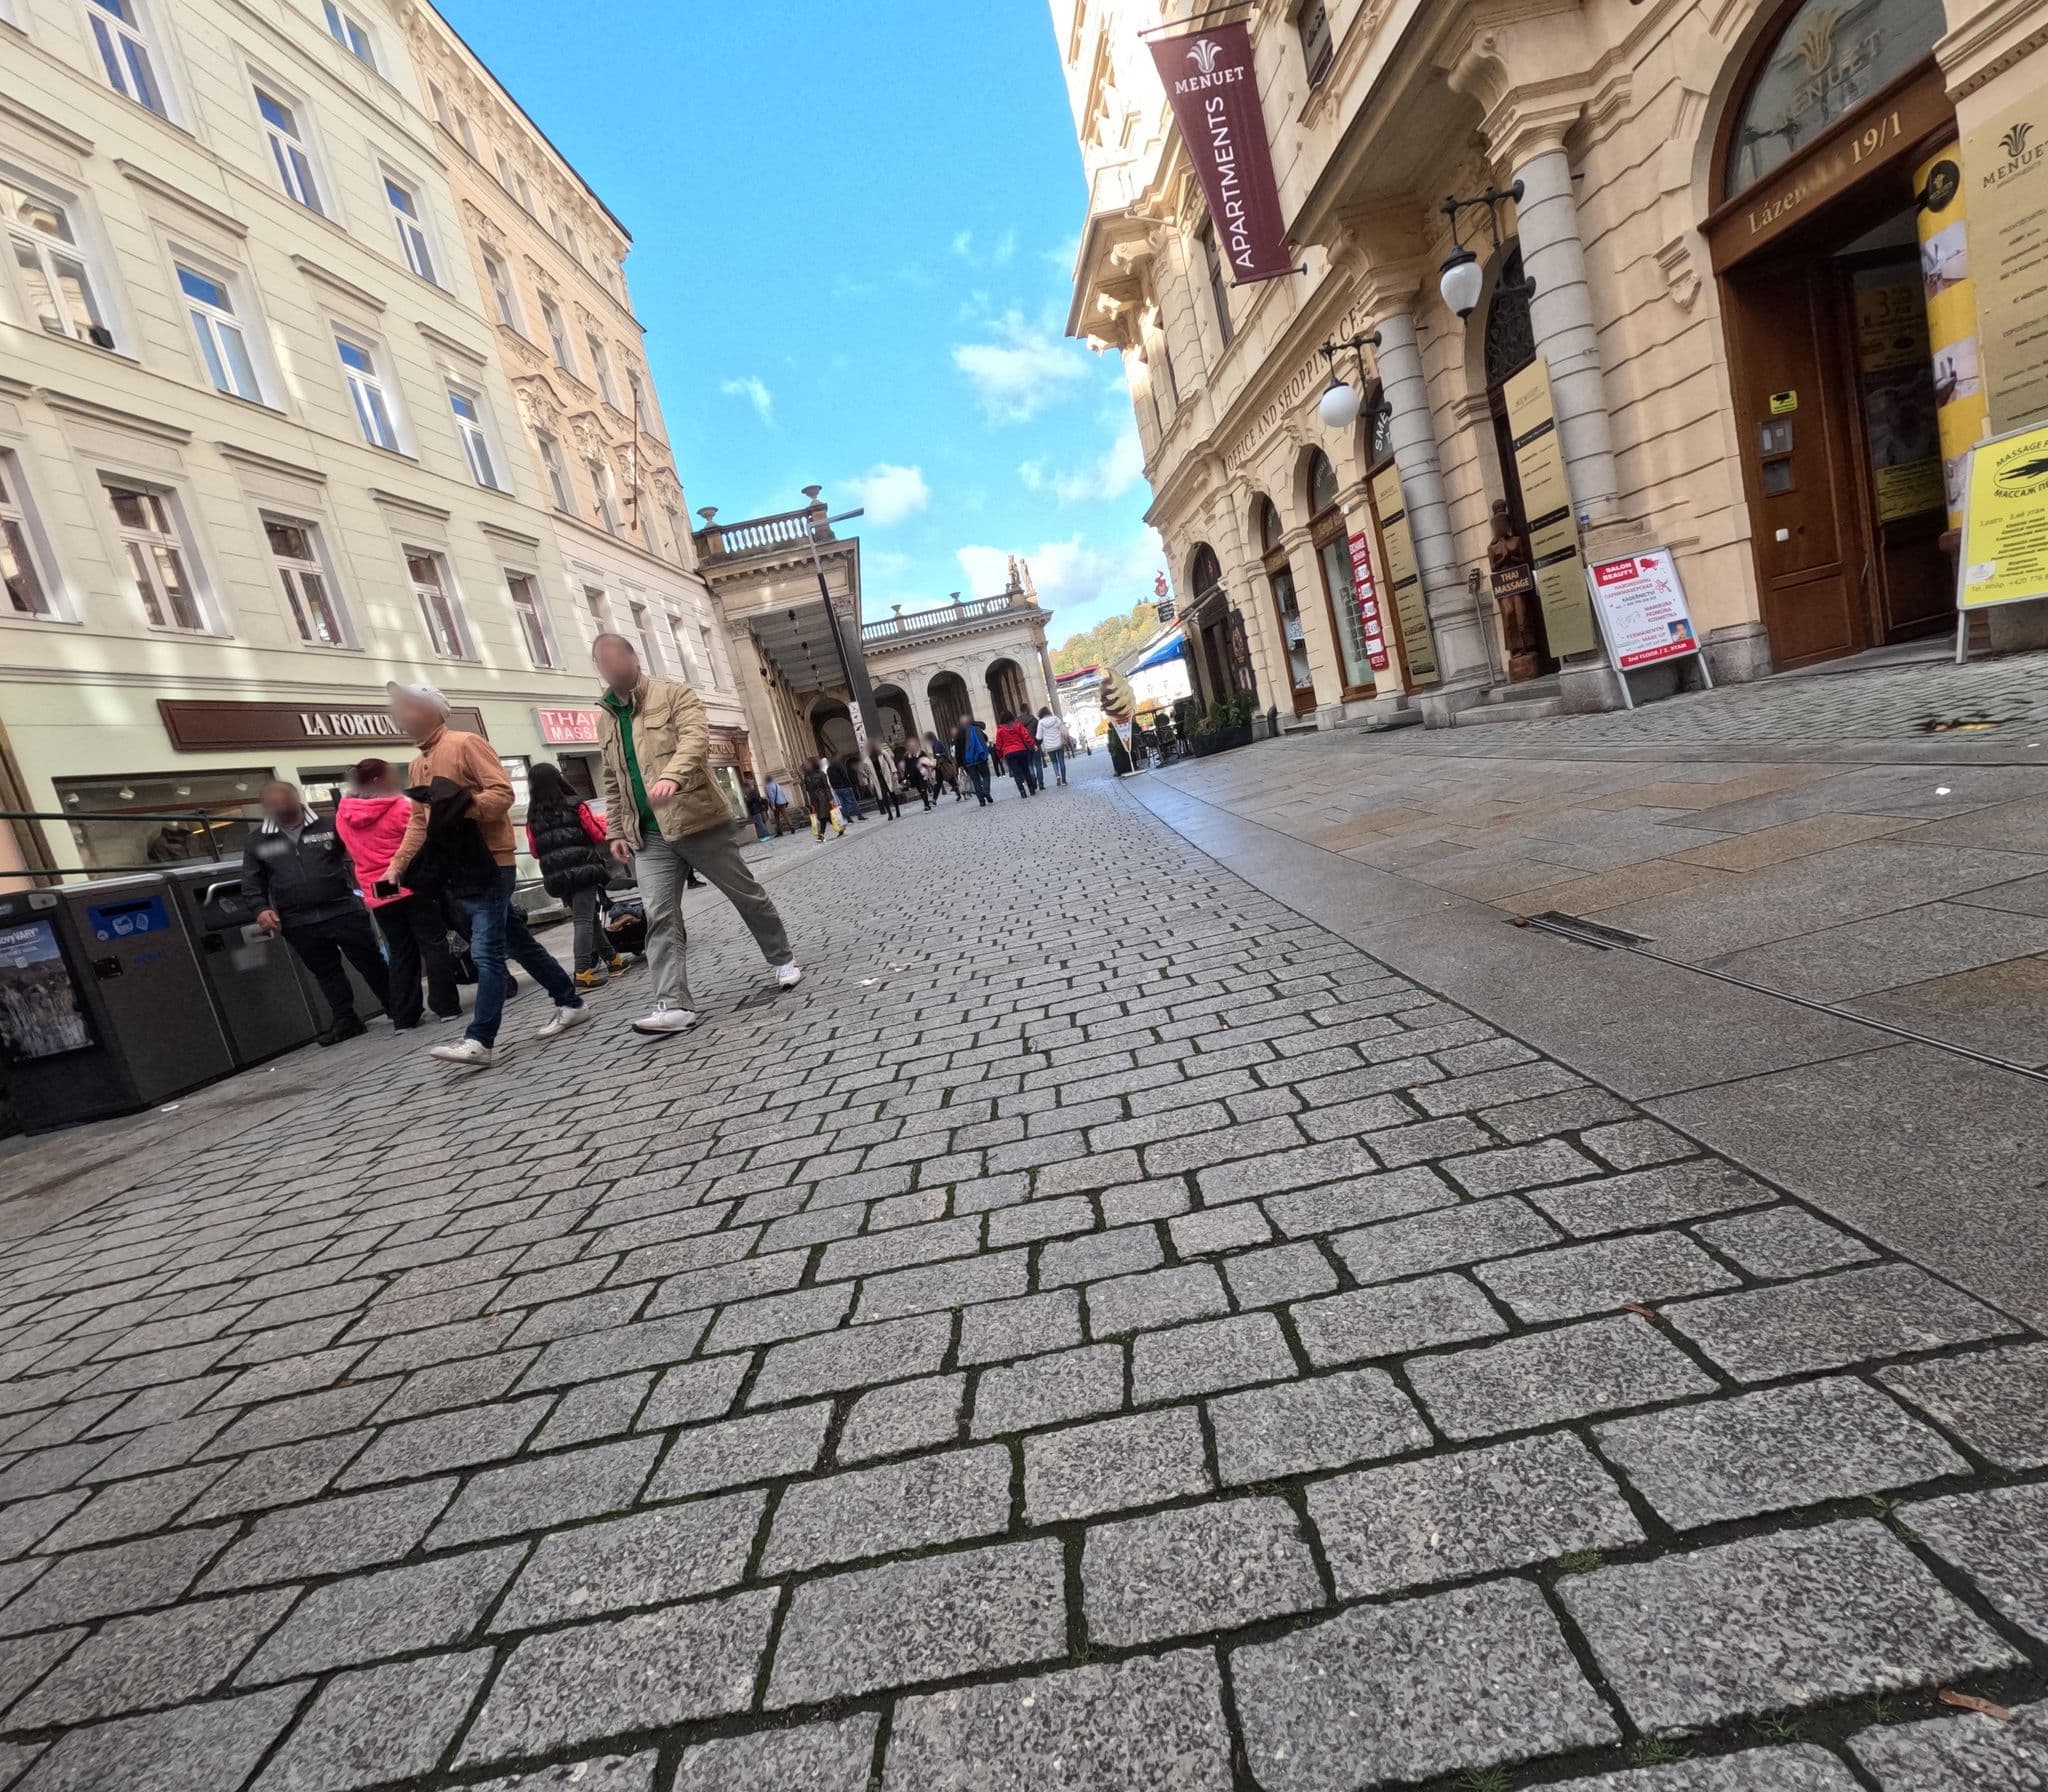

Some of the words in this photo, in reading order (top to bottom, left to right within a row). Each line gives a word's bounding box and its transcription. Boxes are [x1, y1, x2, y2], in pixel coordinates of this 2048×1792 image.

[1174, 66, 1245, 95] MENUET
[1850, 111, 1903, 165] 19/1
[1982, 140, 2048, 190] MENUE
[1205, 96, 1255, 268] APARTMENTS
[1227, 431, 1257, 472] OFFICE
[1256, 404, 1279, 440] AND
[1995, 440, 2043, 468] MASSAGE
[1993, 485, 2037, 499] МАССАЖ
[1500, 570, 1520, 583] THAI
[1602, 568, 1634, 581] BEAUTY
[1605, 562, 1633, 573] SALON
[1494, 577, 1530, 596] MASSAGE
[300, 713, 330, 736] LA
[330, 713, 410, 736] FORTUN
[541, 710, 597, 728] THAI
